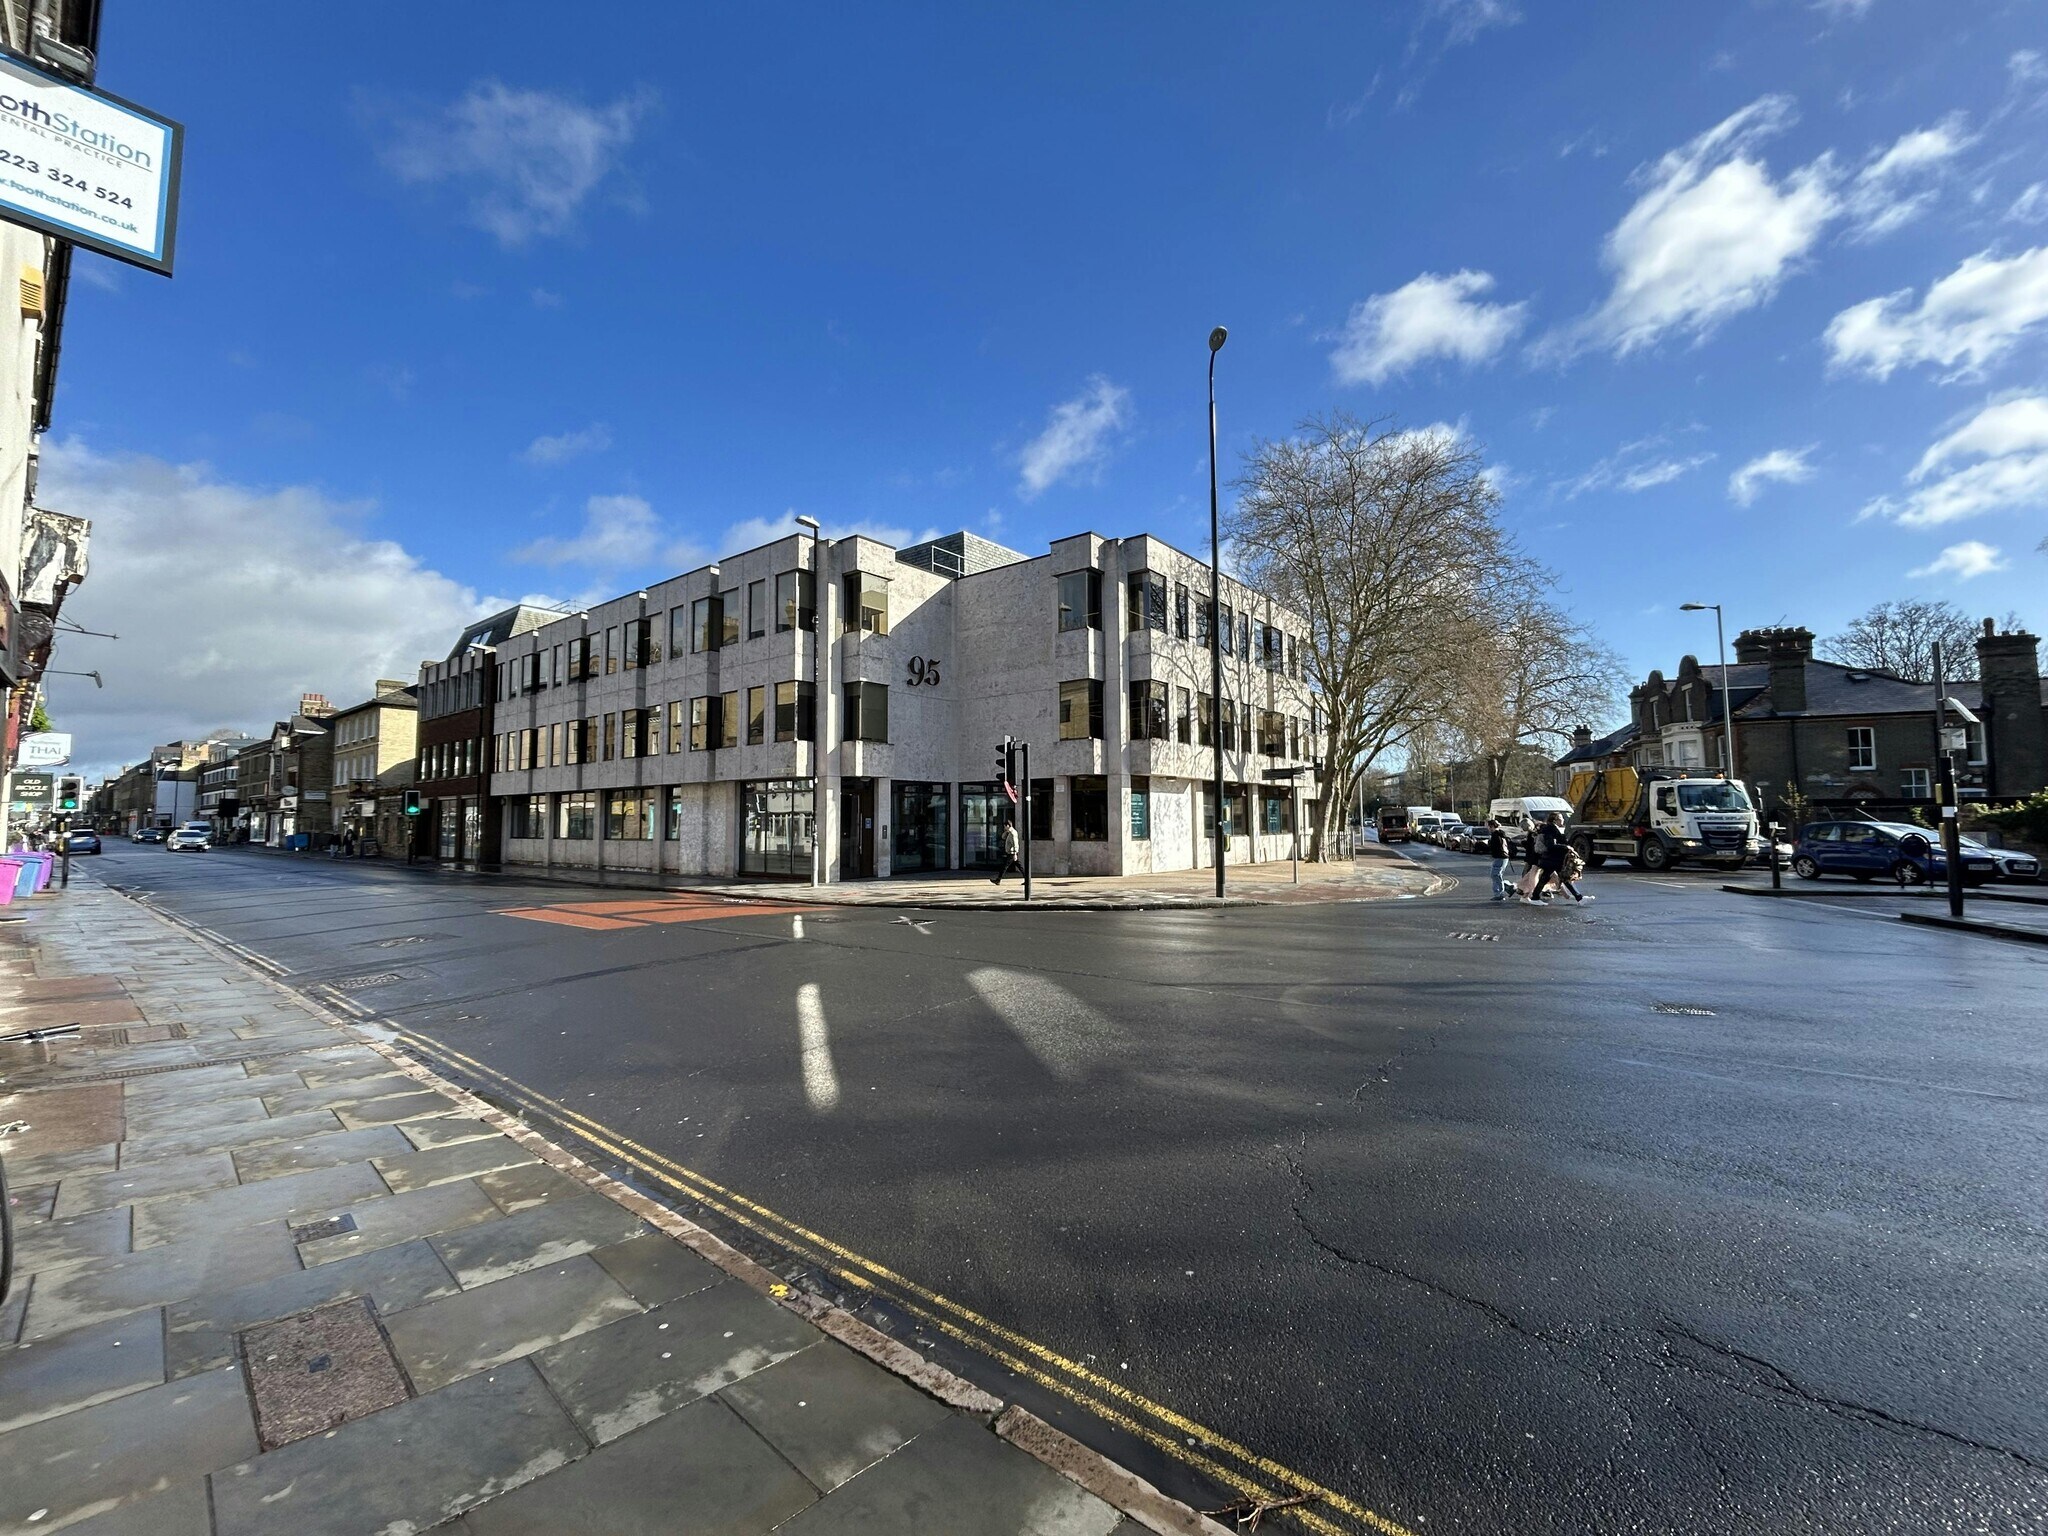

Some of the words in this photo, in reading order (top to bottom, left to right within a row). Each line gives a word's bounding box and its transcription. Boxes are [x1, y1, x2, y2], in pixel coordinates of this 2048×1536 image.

[0, 94, 152, 168] othStation
[0, 113, 47, 139] ENTAL
[54, 135, 122, 168] PRACTICE
[0, 149, 40, 174] 223
[47, 167, 88, 192] 324
[94, 186, 133, 210] 524
[906, 655, 941, 686] 95
[29, 745, 62, 755] THAI
